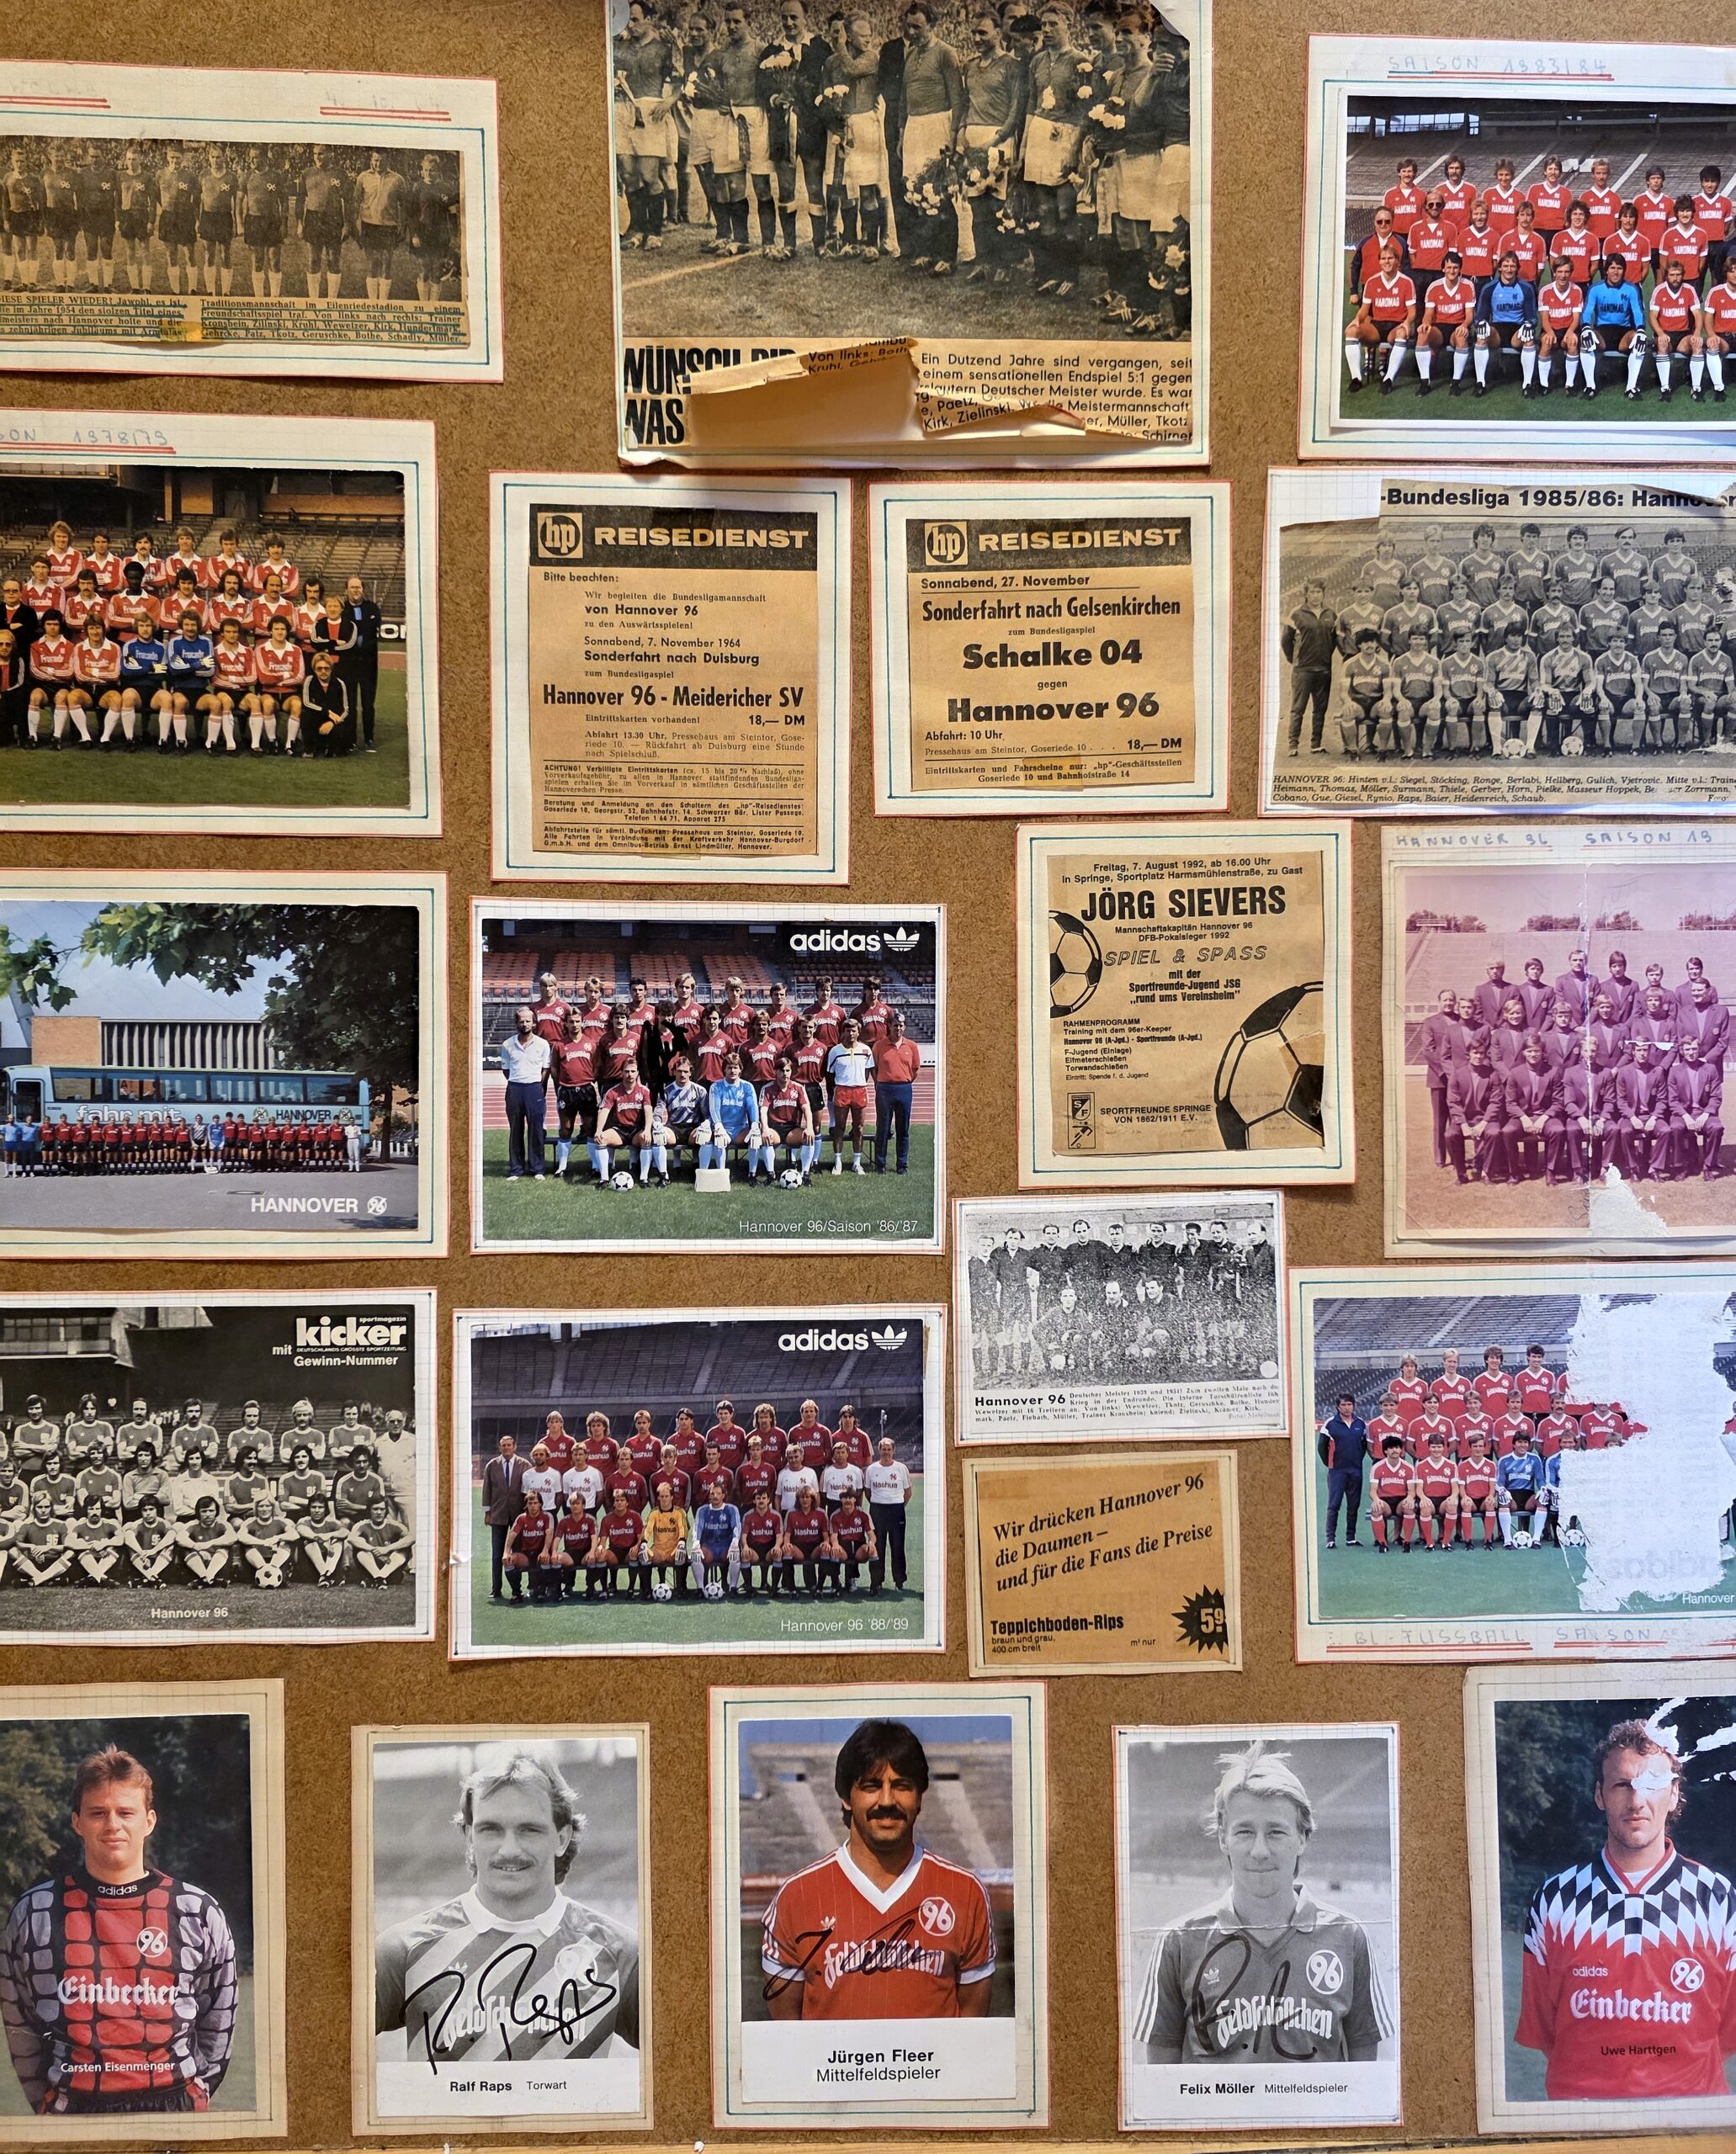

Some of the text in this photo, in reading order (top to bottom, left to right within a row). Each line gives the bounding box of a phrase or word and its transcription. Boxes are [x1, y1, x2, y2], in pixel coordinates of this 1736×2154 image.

[69, 316, 113, 325] Hannover
[922, 354, 1162, 370] Ein Dutzend Jahre sind vergangen,
[924, 369, 1144, 385] einem sensationellen Endspiel 5:1
[982, 385, 1146, 398] Deutscher Meister wurde.
[1519, 490, 1623, 507] 1985/86:
[545, 517, 809, 554] hp REISEDIENST
[932, 527, 1181, 560] hp REISEDIENST
[544, 572, 618, 582] Bitte beachten:
[921, 575, 1090, 590] Sonnabend, 27. November
[672, 593, 766, 603] Bundesligamannschaft
[585, 604, 698, 617] von Hannover 96
[922, 595, 1181, 621] Sonderfahrt nach Gelsenkirchen
[584, 636, 741, 648] Sonnabend, November 1964
[584, 650, 759, 666] Sonderfahrt nach Duisburg
[963, 639, 1142, 670] Schalke 04
[1038, 680, 1068, 691] gegen
[543, 684, 804, 708] Hannover 96 Meidericher SV
[948, 692, 1160, 723] Hannover 96
[586, 714, 647, 724] Eintrittskarten
[784, 715, 804, 726] DM
[926, 730, 981, 741] Abfahrt: 10
[1031, 743, 1086, 754] Goseriede 10
[1161, 738, 1181, 750] DM
[1585, 832, 1671, 844] SAISON
[1094, 857, 1271, 873] Freitag, August 1992, ab 16.00 Uhr
[1074, 874, 1113, 885] Springe,
[1117, 872, 1165, 883] Sportplatz
[1282, 867, 1303, 875] Gast
[1080, 885, 1286, 921] JÖRG SIEVERS
[1115, 923, 1197, 935] Mannschaftskapitän
[1200, 922, 1240, 931] Hannover
[789, 928, 881, 952] adidas
[1104, 945, 1267, 967] SPIEL SPASS
[1169, 969, 1201, 980] mit der
[1224, 979, 1240, 989] JSG
[1064, 1018, 1140, 1027] RAHMENPROGRAMM
[275, 1108, 332, 1122] HANNOVER
[1100, 1104, 1211, 1115] SPORTFREUNDE SPRINGE
[1136, 1115, 1177, 1123] 1862/1911
[1181, 1114, 1198, 1122] E.V.
[251, 1196, 358, 1214] HANNOVER
[739, 1220, 803, 1233] Hannover
[807, 1220, 872, 1234] 96/Saison
[296, 1316, 406, 1346] kicker
[778, 1329, 869, 1351] adidas
[272, 1345, 398, 1366] mit Gewinn-Nummer
[975, 1393, 1065, 1407] Hannover 96
[994, 1472, 1204, 1541] Wir drücken Hannover 96
[995, 1530, 1093, 1567] die Daumen
[996, 1524, 1213, 1591] und für die Fans die Preise
[1683, 1593, 1734, 1605] Hannover
[151, 1606, 229, 1619] Hannover 96
[781, 1619, 844, 1632] Hannover
[847, 1619, 863, 1631] 96
[991, 1615, 1123, 1636] Teppichboden-Rips
[991, 1637, 1015, 1645] braun
[1143, 1637, 1155, 1646] nur
[1022, 1644, 1041, 1653] breit
[98, 1883, 138, 1896] adidas
[1573, 1966, 1608, 1976] adidas
[57, 1975, 180, 2006] Einbecker
[1570, 1988, 1692, 2024] Einbecker
[827, 2049, 934, 2065] Jürgen Fleer
[1601, 2045, 1676, 2056] Uwe Harttgen
[61, 2061, 175, 2072] Carsten Eisenmenger
[816, 2066, 941, 2082] Mittelfeldspieler
[450, 2081, 567, 2093] Ralf Raps Torwart
[1180, 2082, 1348, 2094] Felix Möller Mittelfeldspieler
